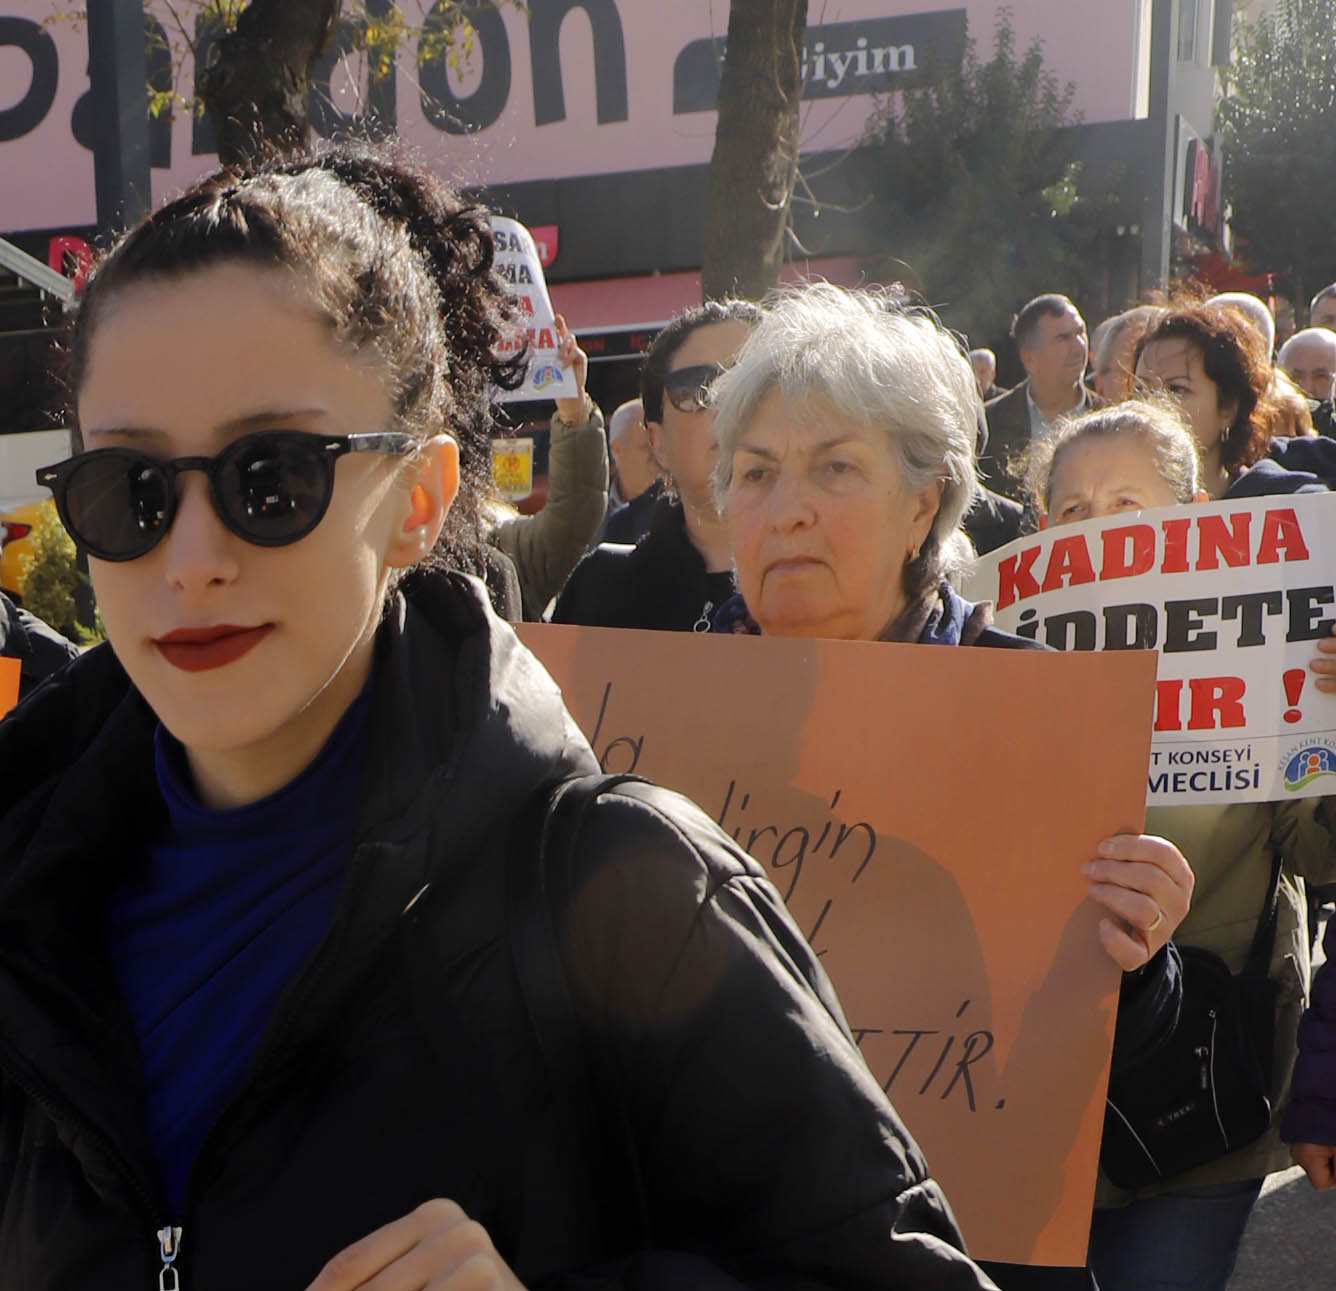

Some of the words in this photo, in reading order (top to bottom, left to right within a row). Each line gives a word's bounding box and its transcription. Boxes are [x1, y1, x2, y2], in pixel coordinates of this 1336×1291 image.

[800, 37, 918, 88] iyim
[996, 508, 1310, 611] KADINA
[1016, 586, 1335, 653] İDDETE
[1168, 744, 1252, 766] KONSEYİ
